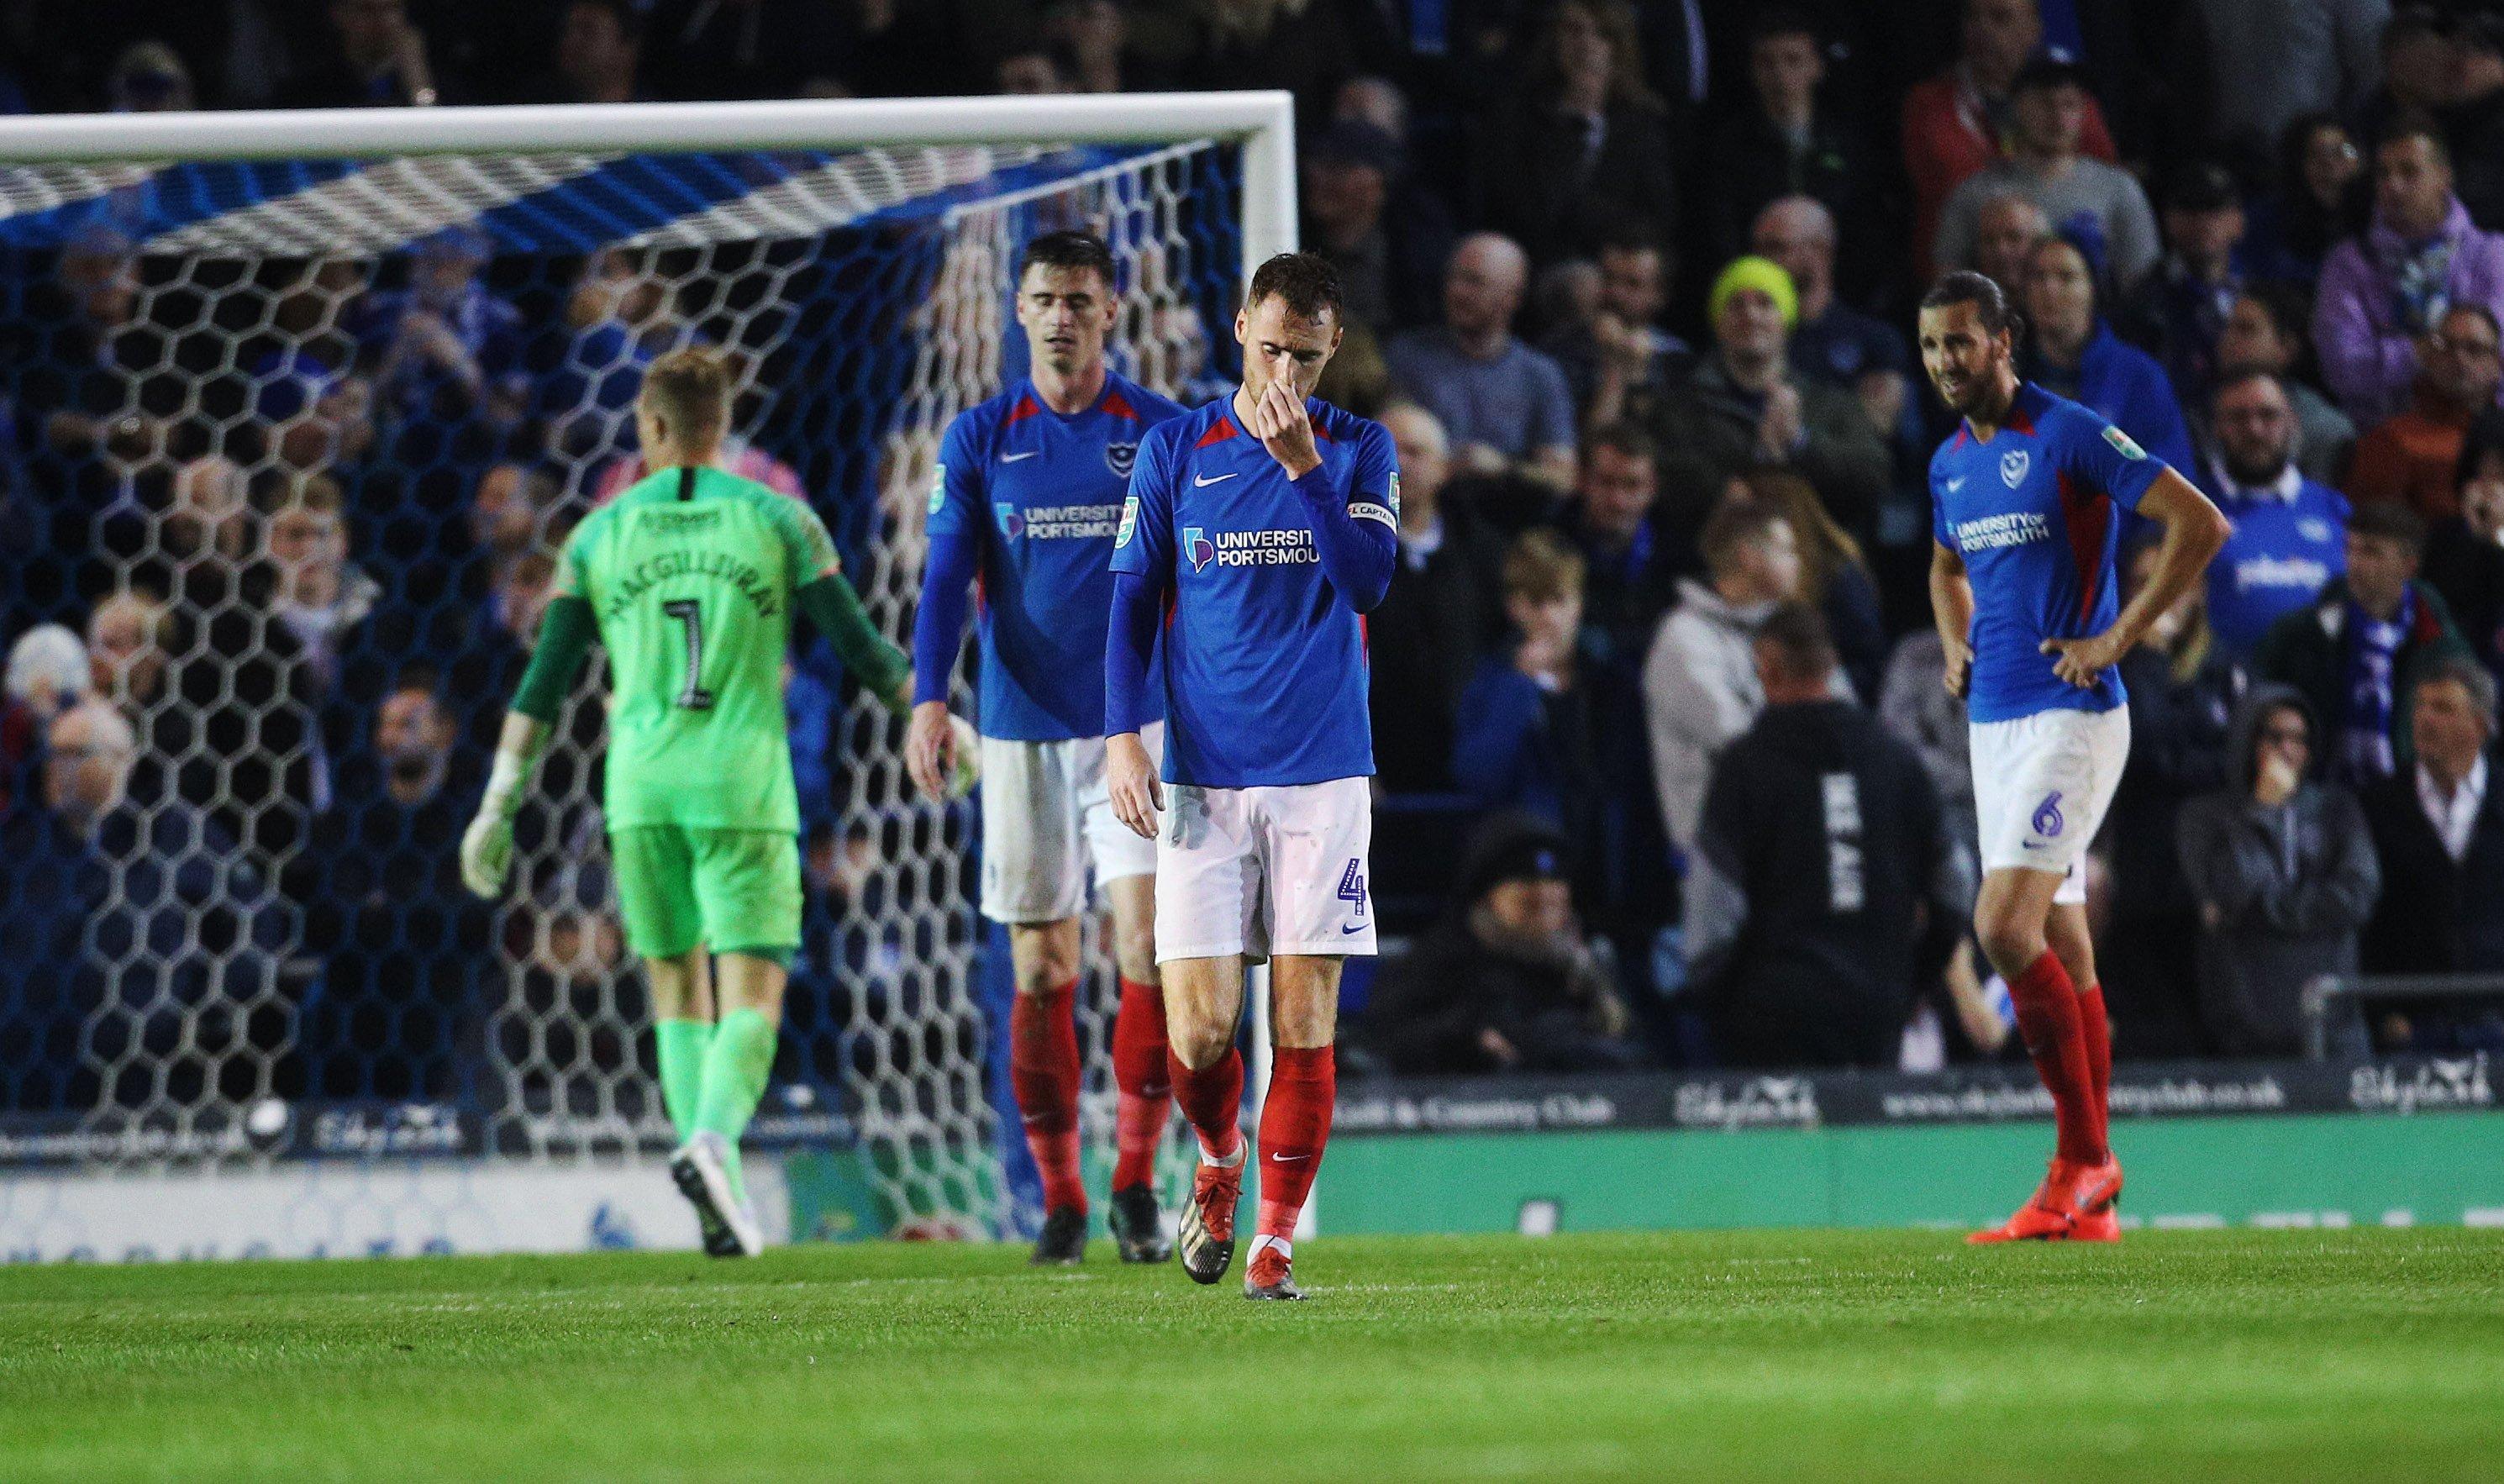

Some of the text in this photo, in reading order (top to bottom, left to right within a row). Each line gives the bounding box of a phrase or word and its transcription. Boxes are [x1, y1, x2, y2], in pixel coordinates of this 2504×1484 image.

[1025, 505, 1123, 523] UNIVERSIT
[1956, 512, 2029, 538] UNIVERSITY
[1027, 521, 1120, 539] PORTSMOU
[1215, 529, 1312, 549] UNIVERSIT
[1960, 525, 2050, 553] PORTSMOUTH
[1218, 548, 1320, 567] PORTSMOU
[662, 599, 712, 709] 1
[2032, 790, 2063, 837] 6
[1338, 858, 1366, 916] 4
